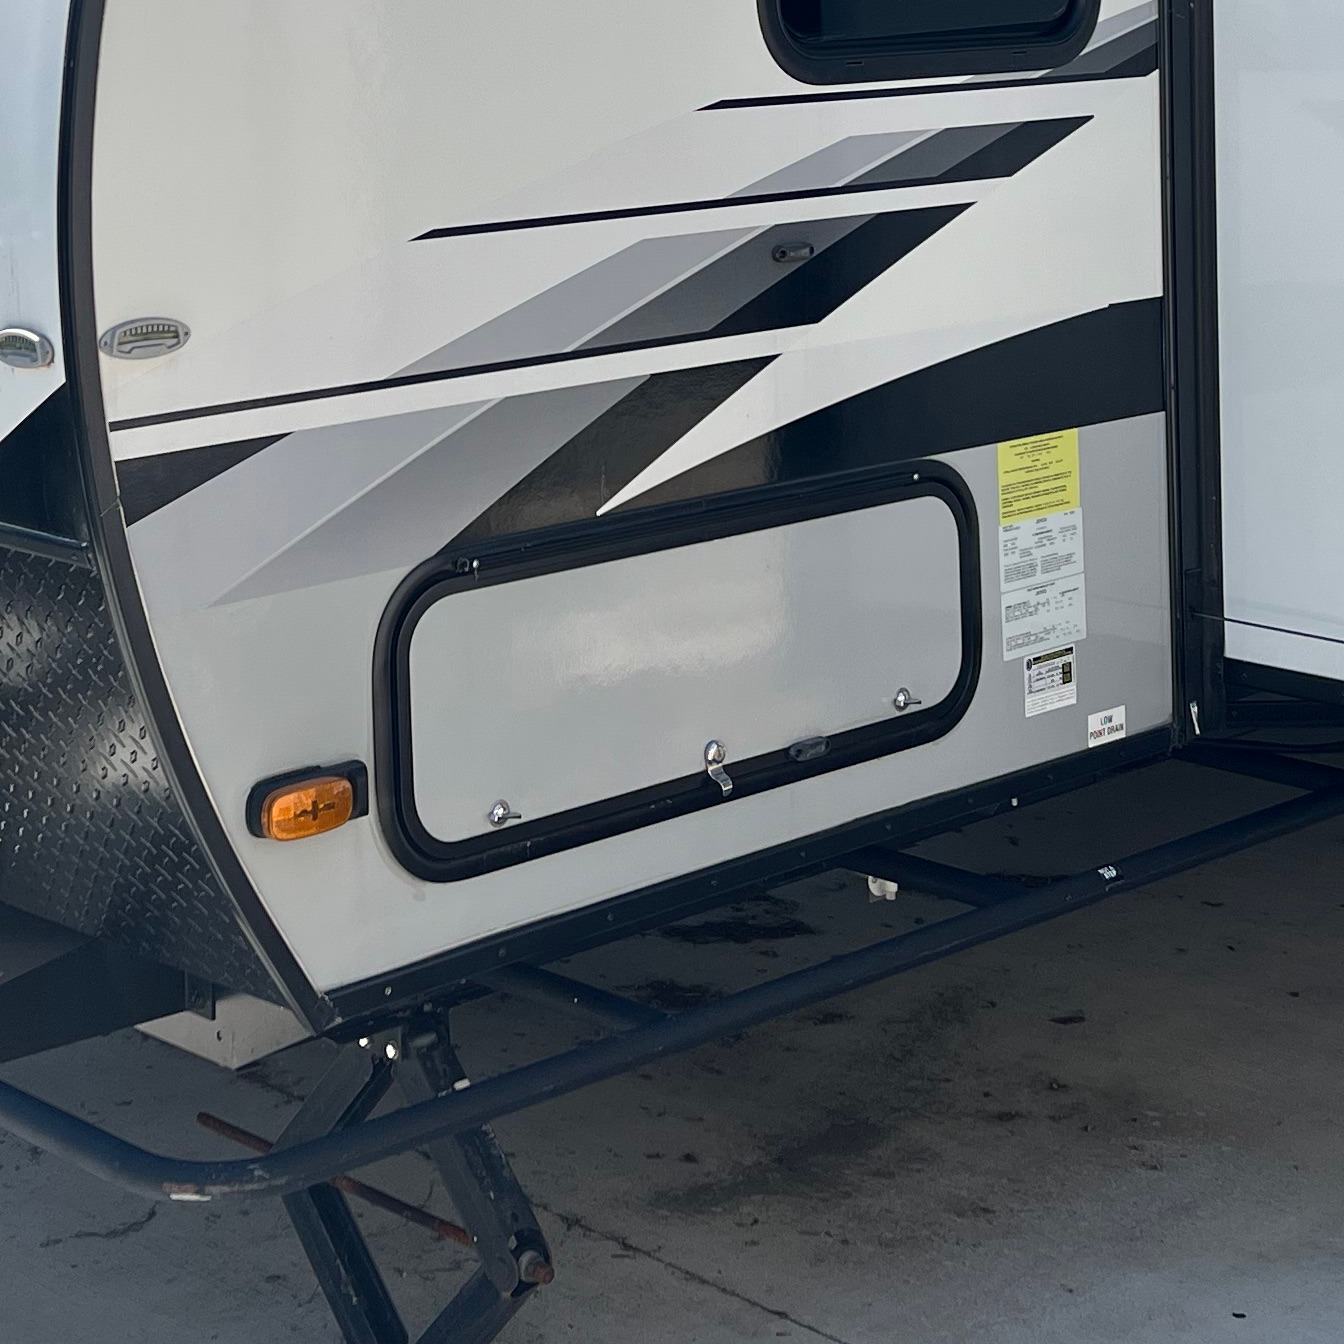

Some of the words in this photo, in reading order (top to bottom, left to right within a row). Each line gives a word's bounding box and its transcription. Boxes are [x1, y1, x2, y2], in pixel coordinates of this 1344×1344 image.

[1099, 714, 1114, 726] LOW
[1089, 727, 1106, 740] POINT
[1107, 723, 1124, 735] DRAIN
